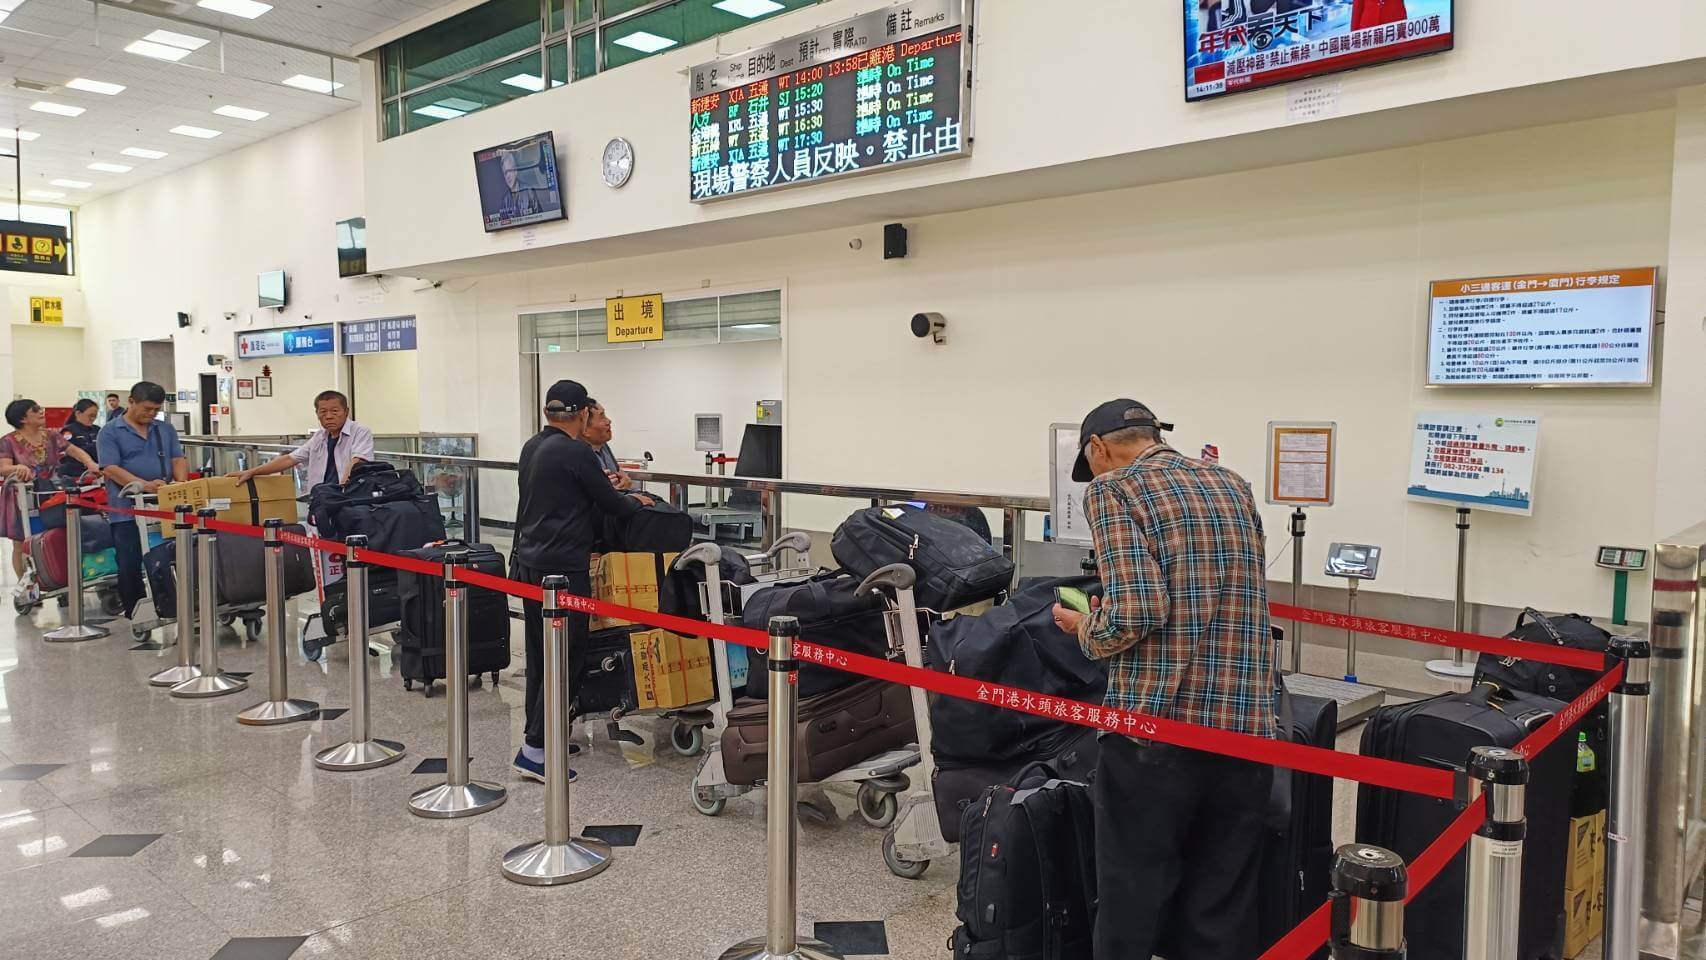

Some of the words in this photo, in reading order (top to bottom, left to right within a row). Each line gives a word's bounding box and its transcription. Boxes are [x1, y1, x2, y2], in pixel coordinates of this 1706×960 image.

[748, 51, 775, 77] 目的地
[914, 12, 945, 29] Remarks
[778, 75, 791, 89] WT
[795, 66, 823, 85] 14:00
[828, 57, 857, 77] 13:58
[901, 31, 962, 58] Departure
[748, 96, 769, 115] 石井
[795, 82, 823, 102] 15:20
[887, 64, 901, 78] On
[906, 56, 934, 73] Time
[778, 106, 791, 121] WT
[795, 98, 823, 118] 15:30
[886, 80, 901, 95] On
[906, 74, 934, 91] Time
[777, 137, 790, 152] WT
[794, 130, 823, 149] 17:30
[886, 114, 901, 129] On
[906, 108, 934, 125] Time
[778, 122, 790, 137] WT
[795, 114, 823, 134] 16:30
[886, 97, 901, 112] On
[906, 91, 934, 108] Time
[615, 326, 653, 337] Departure
[792, 641, 848, 666] 客服務中心
[976, 683, 1157, 735] 金門港水頭旅客服務中心
